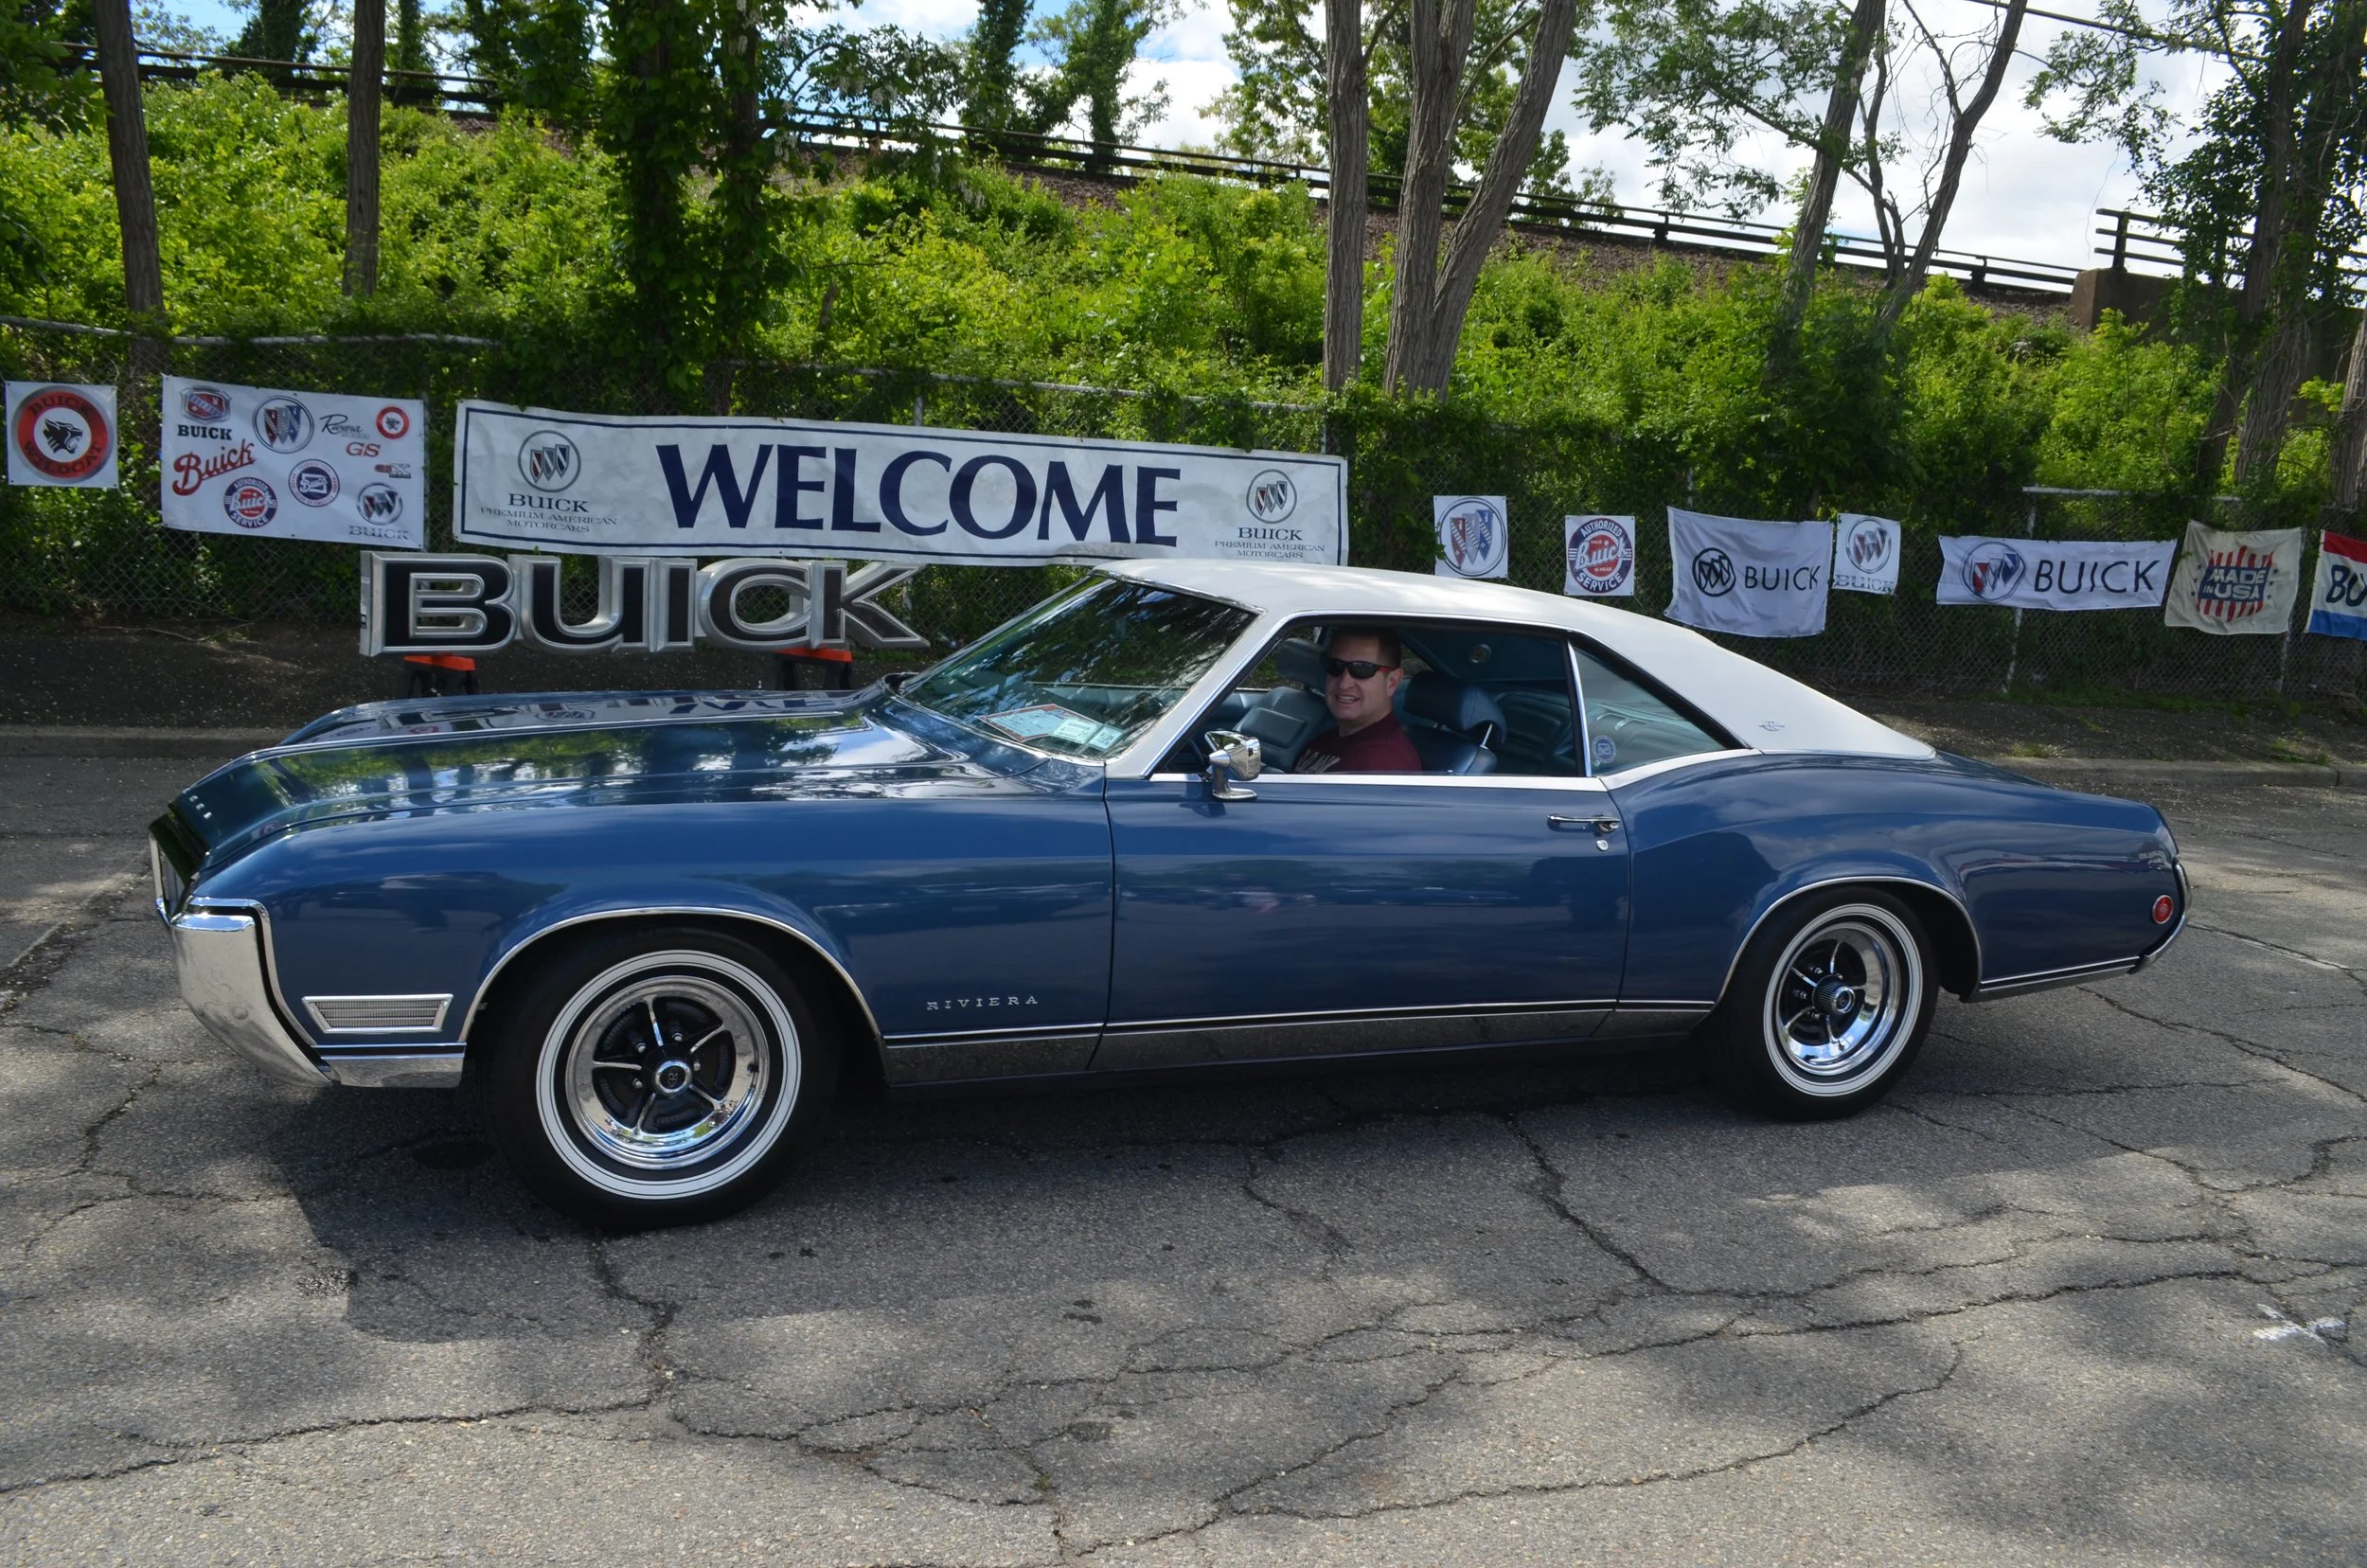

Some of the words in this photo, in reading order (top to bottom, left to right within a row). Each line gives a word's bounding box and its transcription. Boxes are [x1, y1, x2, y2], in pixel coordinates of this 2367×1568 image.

[177, 424, 232, 441] BUICK
[346, 441, 382, 458] GS
[172, 438, 257, 496] Buick
[229, 490, 275, 512] Buick
[507, 492, 590, 513] BUICK
[656, 443, 1181, 547] WELCOME
[230, 512, 269, 527] SERVICE
[480, 507, 543, 519] PREMIUM
[546, 514, 616, 525] AMERICAN
[347, 525, 410, 540] BUICK
[507, 519, 590, 533] MOTORCARS
[1237, 526, 1304, 541] BUICK
[1580, 520, 1623, 537] AUTHORIZED
[1214, 541, 1266, 549] PREMIUM
[1269, 543, 1326, 552] AMERICAN
[1237, 549, 1304, 559] MOTORCARS
[1575, 537, 1628, 570] Buick
[1576, 572, 1623, 592] SERVICE
[1744, 564, 1822, 591] BUICK
[1834, 574, 1895, 594] BUICK
[2034, 559, 2161, 595] BUICK
[2207, 568, 2266, 585] MADE
[2202, 584, 2214, 595] IN
[2214, 583, 2260, 600] USA
[360, 550, 931, 657] BUICK
[926, 995, 1039, 1011] RIVIERA
